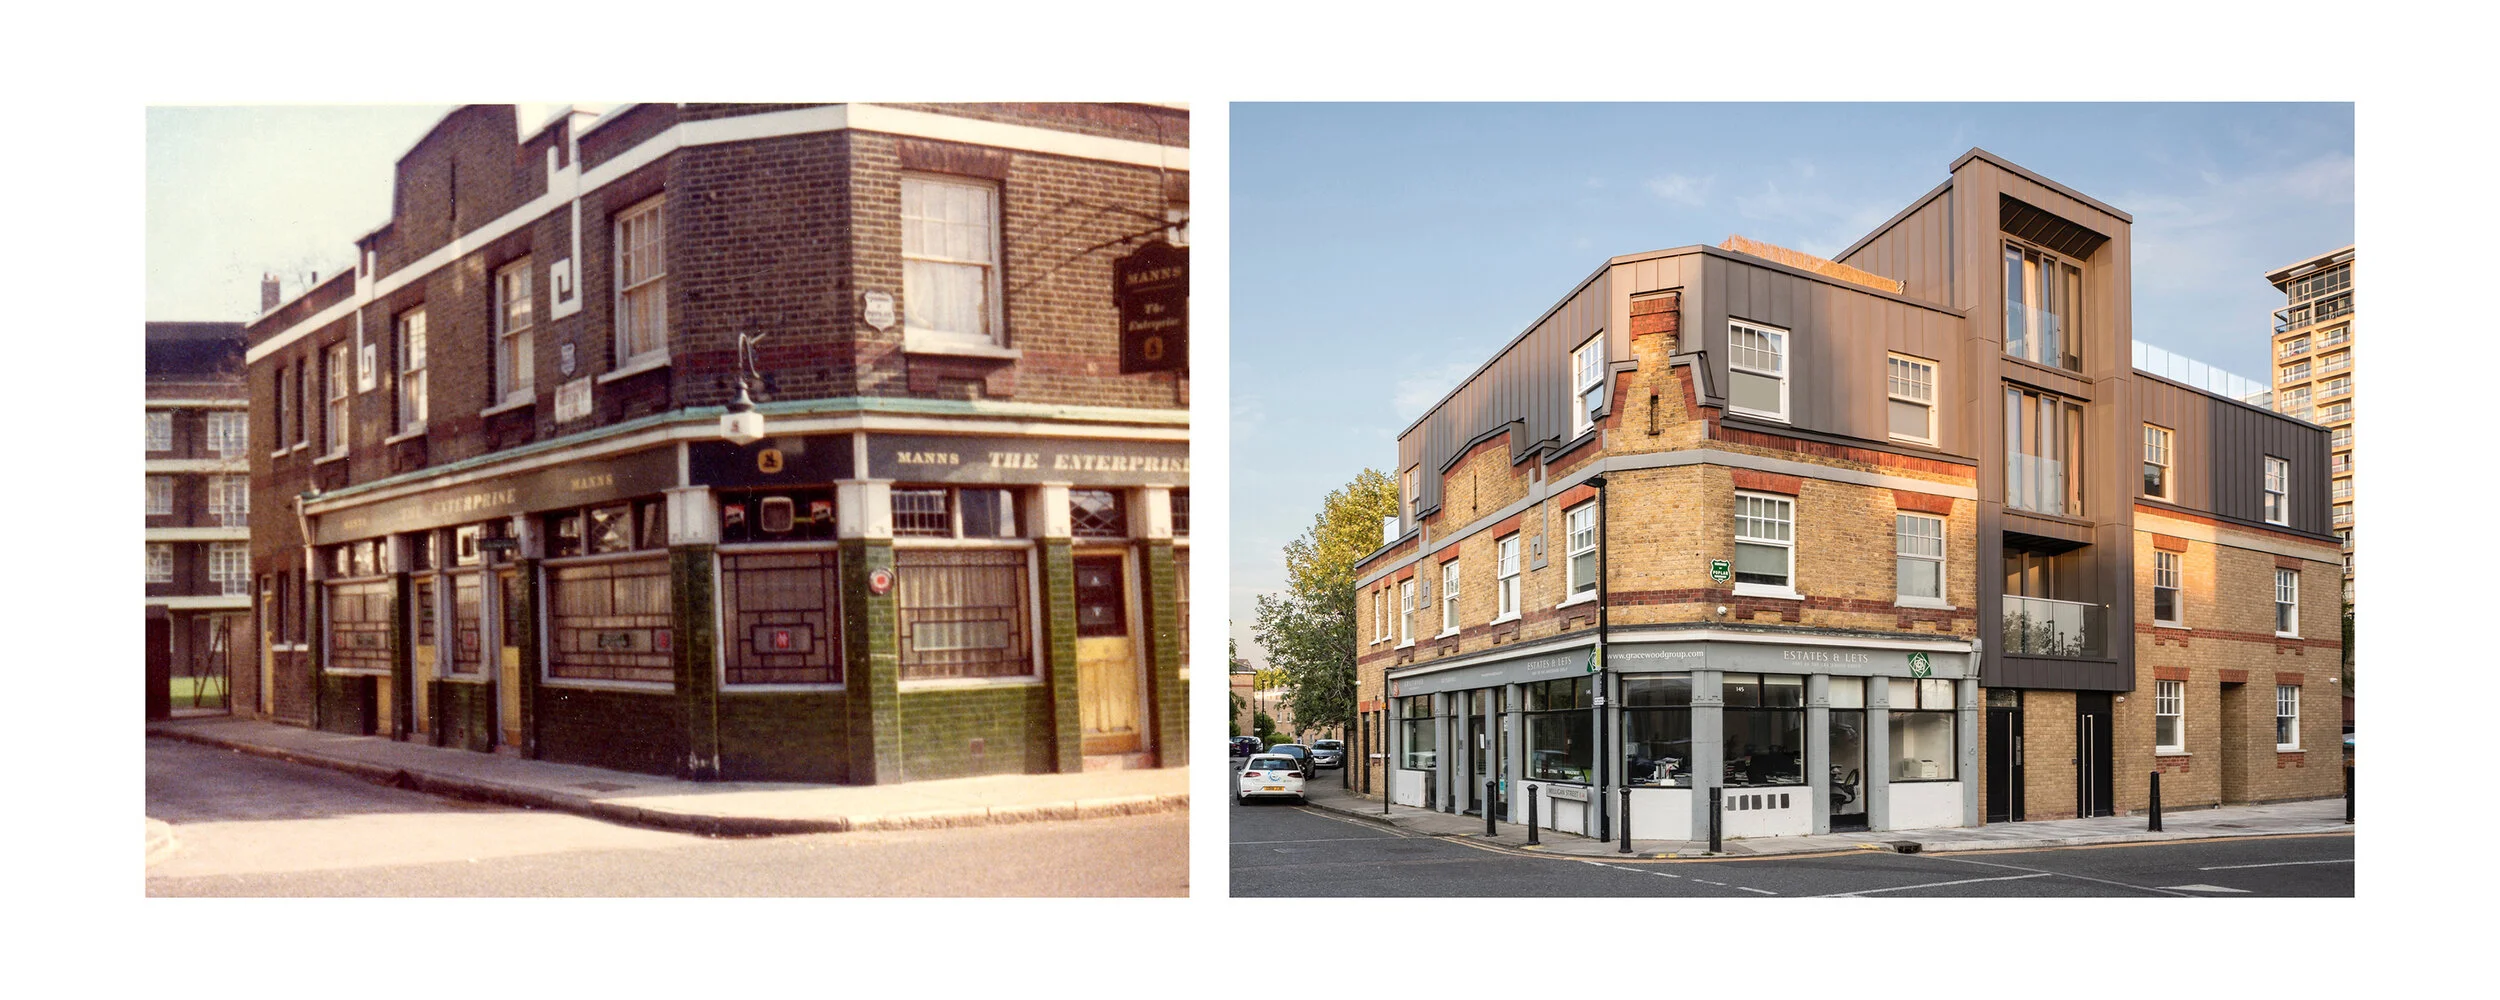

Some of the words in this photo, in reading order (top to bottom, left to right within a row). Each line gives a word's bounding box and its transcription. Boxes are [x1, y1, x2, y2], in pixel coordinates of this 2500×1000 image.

[1126, 266, 1182, 284] MANNS
[897, 451, 960, 465] MANNS
[988, 451, 1040, 469] THE
[432, 488, 516, 516] ENTERPRISE
[570, 473, 613, 491] MANNS
[1527, 659, 1550, 671] ESTATES
[1558, 656, 1572, 667] LETS
[1607, 651, 1704, 661] www.gracewoodgroup.com
[1784, 650, 1828, 662] ESTATES
[1833, 653, 1840, 662] &
[1845, 653, 1868, 663] LETS
